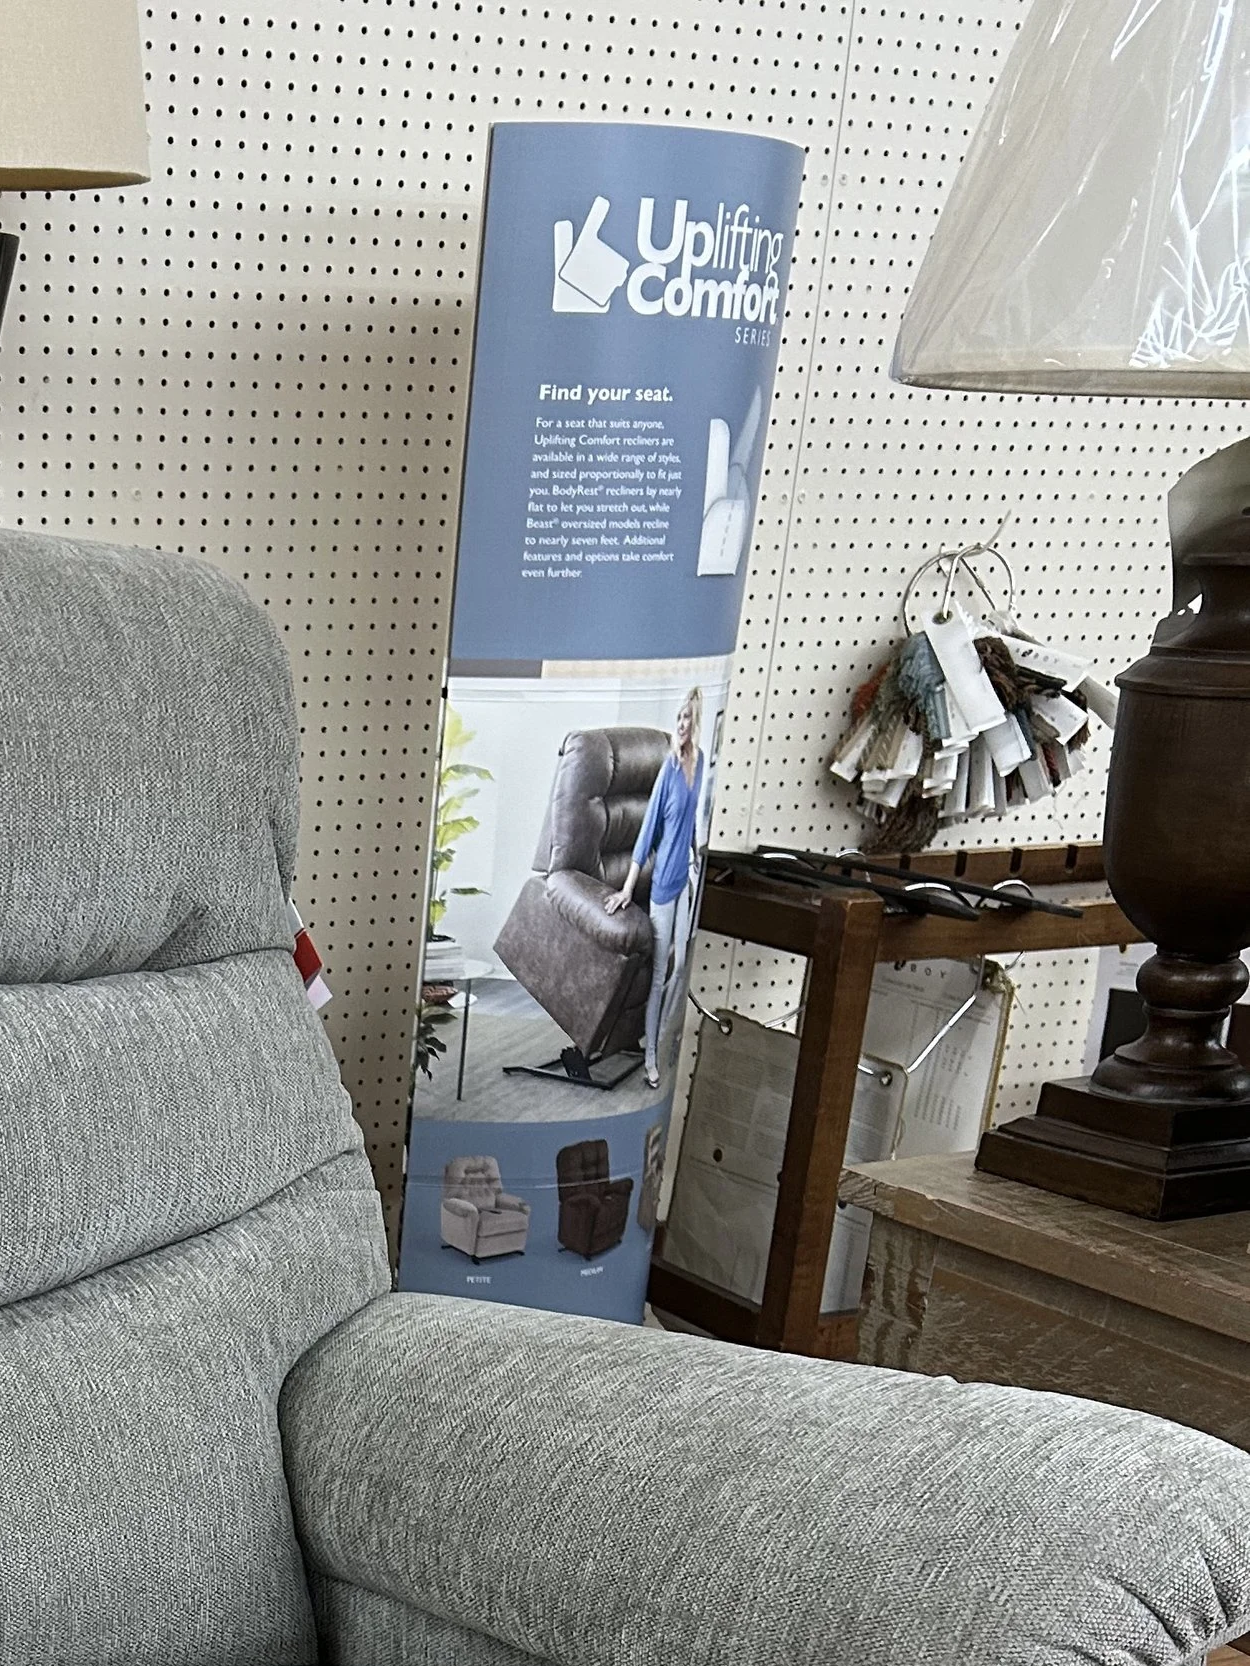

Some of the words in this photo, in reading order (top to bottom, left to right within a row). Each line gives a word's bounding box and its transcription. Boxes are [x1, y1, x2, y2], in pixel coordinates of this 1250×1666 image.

[637, 197, 784, 289] Uplifting
[626, 262, 780, 325] Comfort
[734, 326, 771, 347] SERIES
[539, 384, 582, 400] Find
[587, 388, 631, 405] your
[635, 386, 673, 401] seat.
[536, 417, 553, 428] For
[556, 420, 562, 428] a
[565, 418, 585, 428] seat
[588, 417, 606, 428] that
[610, 418, 630, 428] suits
[534, 434, 576, 448] Uplifting
[579, 435, 620, 445] Comfort
[623, 436, 659, 446] recliners
[662, 438, 674, 446] are
[533, 452, 574, 462] available
[577, 452, 585, 462] in
[588, 454, 593, 462] a
[597, 452, 618, 462] wide
[621, 454, 645, 465] range
[648, 452, 657, 462] of
[531, 469, 549, 479] and
[552, 469, 576, 479] sized
[579, 469, 644, 481] proportionally
[646, 470, 656, 479] to
[658, 469, 666, 479] fit
[668, 470, 682, 481] just
[606, 485, 644, 496] recliners
[659, 486, 682, 499] nearly
[528, 502, 544, 513] flat
[547, 503, 557, 513] to
[561, 502, 573, 513] let
[576, 504, 594, 515] you
[597, 502, 628, 513] stretch
[649, 502, 670, 513] while
[561, 518, 606, 529] oversized
[609, 519, 640, 529] models
[643, 519, 669, 529] recline
[525, 536, 536, 545] to
[539, 535, 568, 547] nearly
[572, 537, 597, 545] seven
[623, 535, 666, 546] Additional
[523, 551, 562, 561] features
[565, 552, 583, 561] and
[585, 553, 619, 564] options
[622, 551, 640, 561] take
[642, 551, 674, 562] comfort
[522, 569, 544, 578] even
[466, 1275, 492, 1285] PETITE
